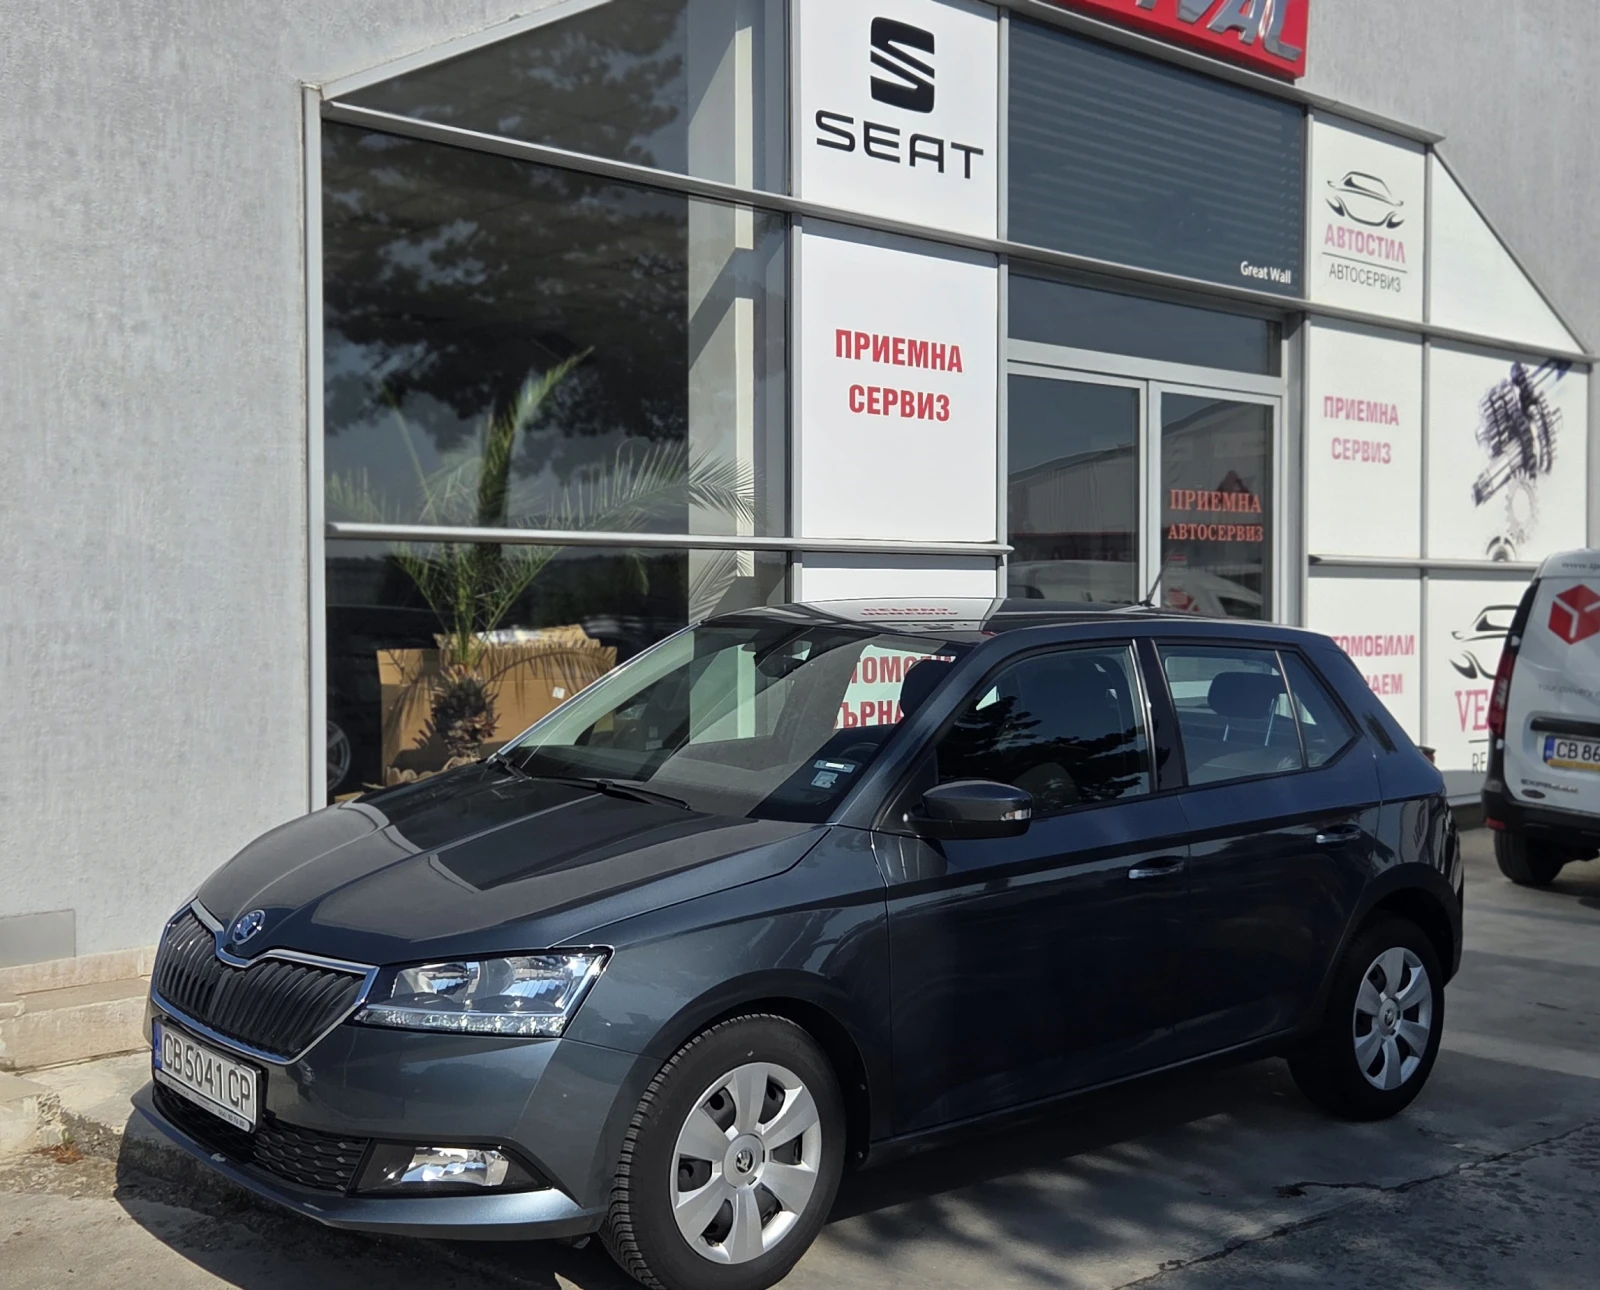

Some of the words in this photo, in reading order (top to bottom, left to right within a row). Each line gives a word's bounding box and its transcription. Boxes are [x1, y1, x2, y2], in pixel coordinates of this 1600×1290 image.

[815, 109, 984, 180] SEAT
[1324, 223, 1406, 264] АВТОСТИЛ
[1240, 261, 1268, 280] Great
[1269, 266, 1292, 284] Wall
[1328, 263, 1402, 293] АВТОСЕРВИЗ
[835, 328, 964, 373] ПРИЕМНА
[848, 384, 951, 422] СЕРВИЗ
[1323, 395, 1400, 426] ПРИЕМНА
[1331, 437, 1392, 464] СЕРВИЗ
[1169, 488, 1262, 513] ПРИЕМНА
[1168, 523, 1263, 543] АВТОСЕРВИЗ
[1557, 742, 1578, 759] CB
[185, 1045, 224, 1100] 5041
